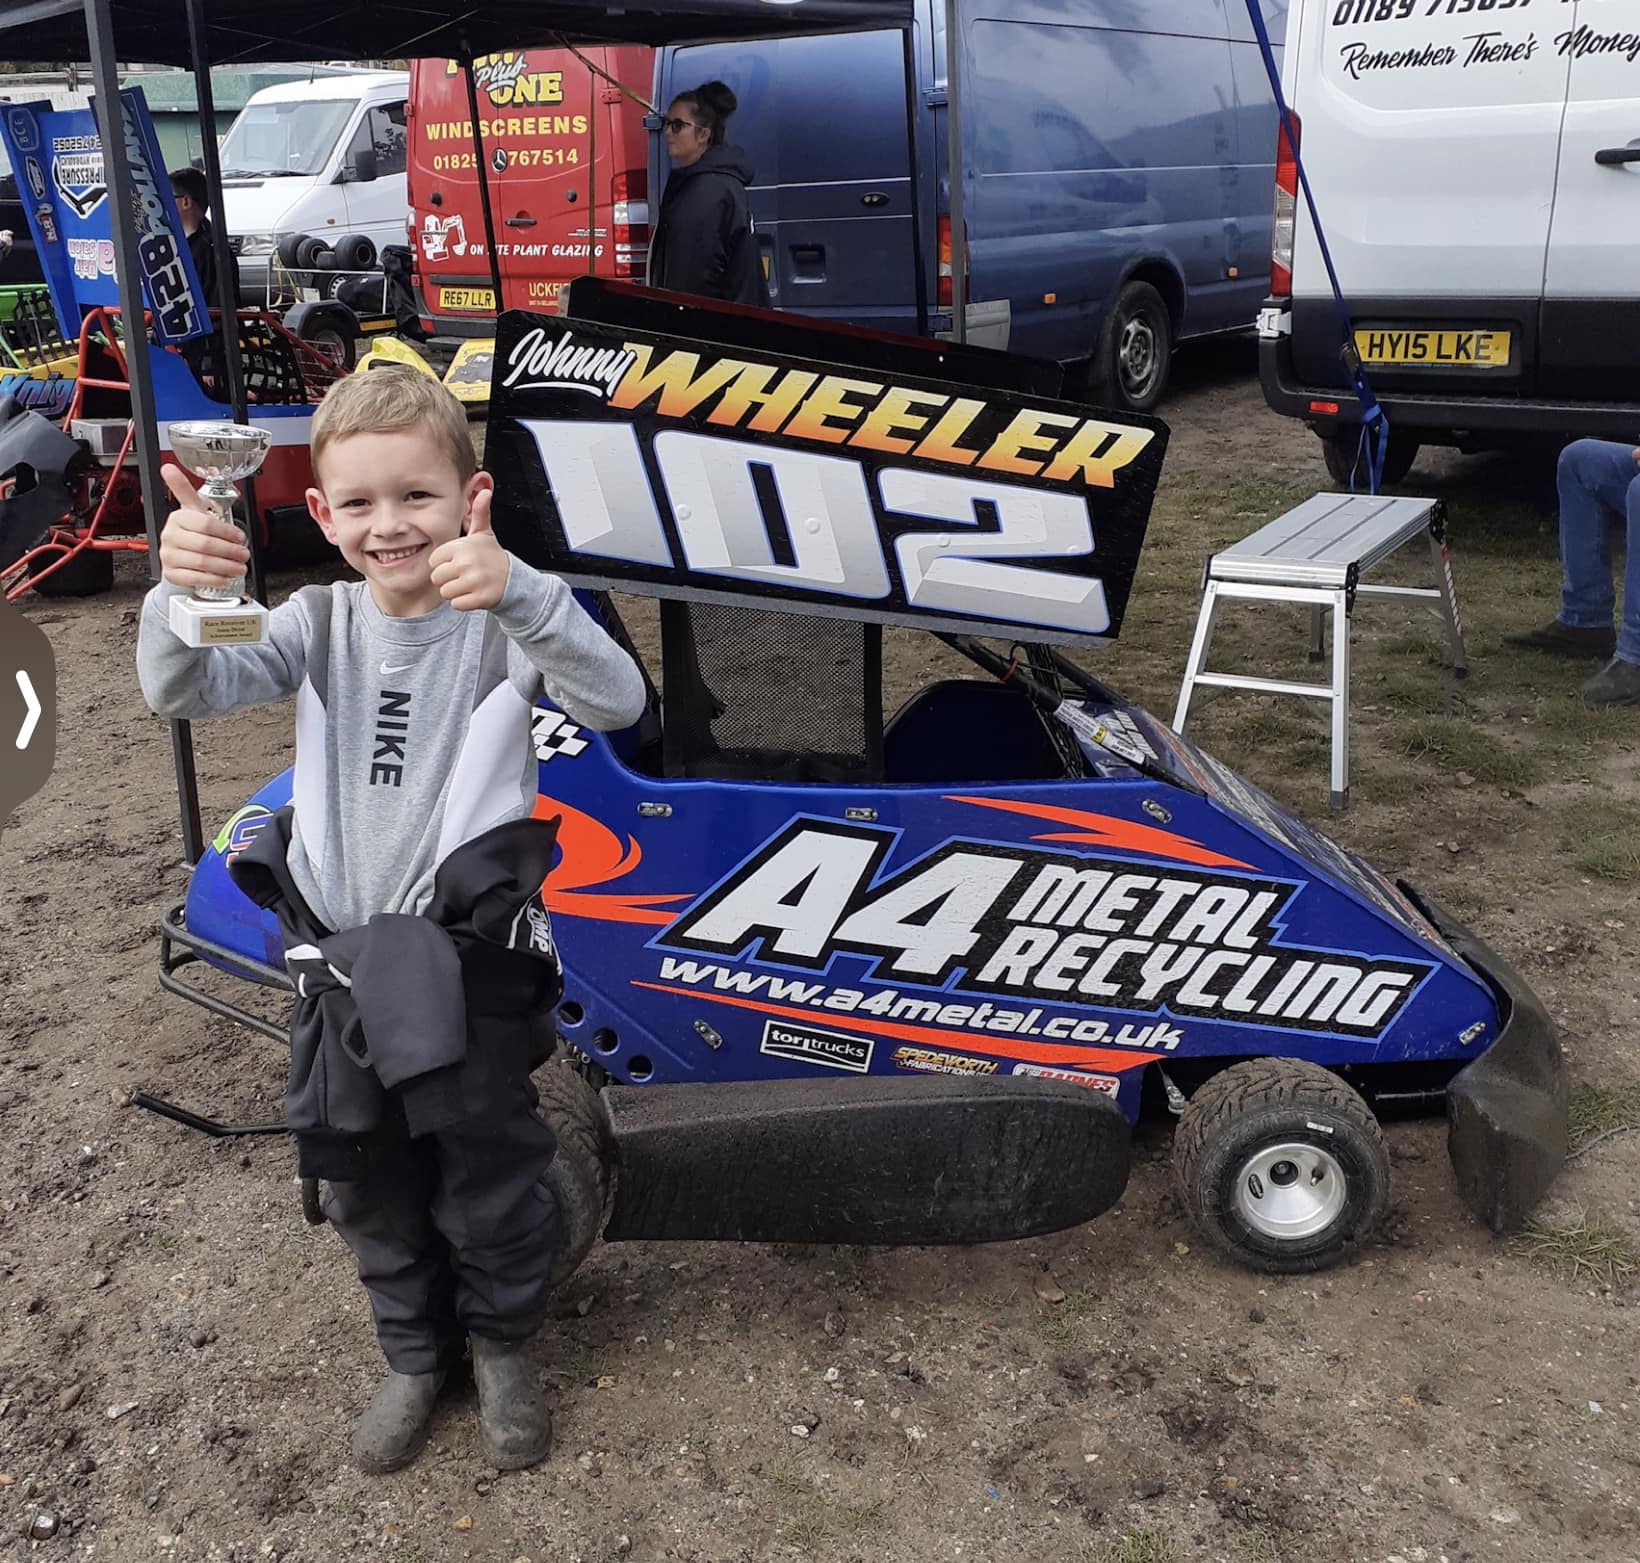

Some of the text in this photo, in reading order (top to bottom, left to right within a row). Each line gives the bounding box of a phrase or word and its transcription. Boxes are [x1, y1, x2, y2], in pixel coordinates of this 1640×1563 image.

[1340, 24, 1640, 80] Remember There's Money
[426, 115, 588, 140] WINDSCREENS
[433, 149, 579, 170] 01825 767514
[470, 244, 484, 256] ON
[513, 244, 548, 256] PLANT
[138, 233, 195, 338] 428
[444, 291, 491, 307] RE67 LLR
[529, 282, 569, 297] UCKF
[1367, 334, 1493, 360] HY15 LKE
[502, 328, 1155, 488] Johnny WHEELER
[515, 419, 1111, 634] 102
[369, 690, 412, 787] NIKE
[682, 829, 1025, 975] A4
[1006, 863, 1279, 950] METAL
[533, 909, 550, 953] OMP
[659, 957, 1185, 1050] www.a4metal.co.uk
[975, 924, 1416, 1028] RECYCLING
[894, 1047, 999, 1073] SPEDEWORTH
